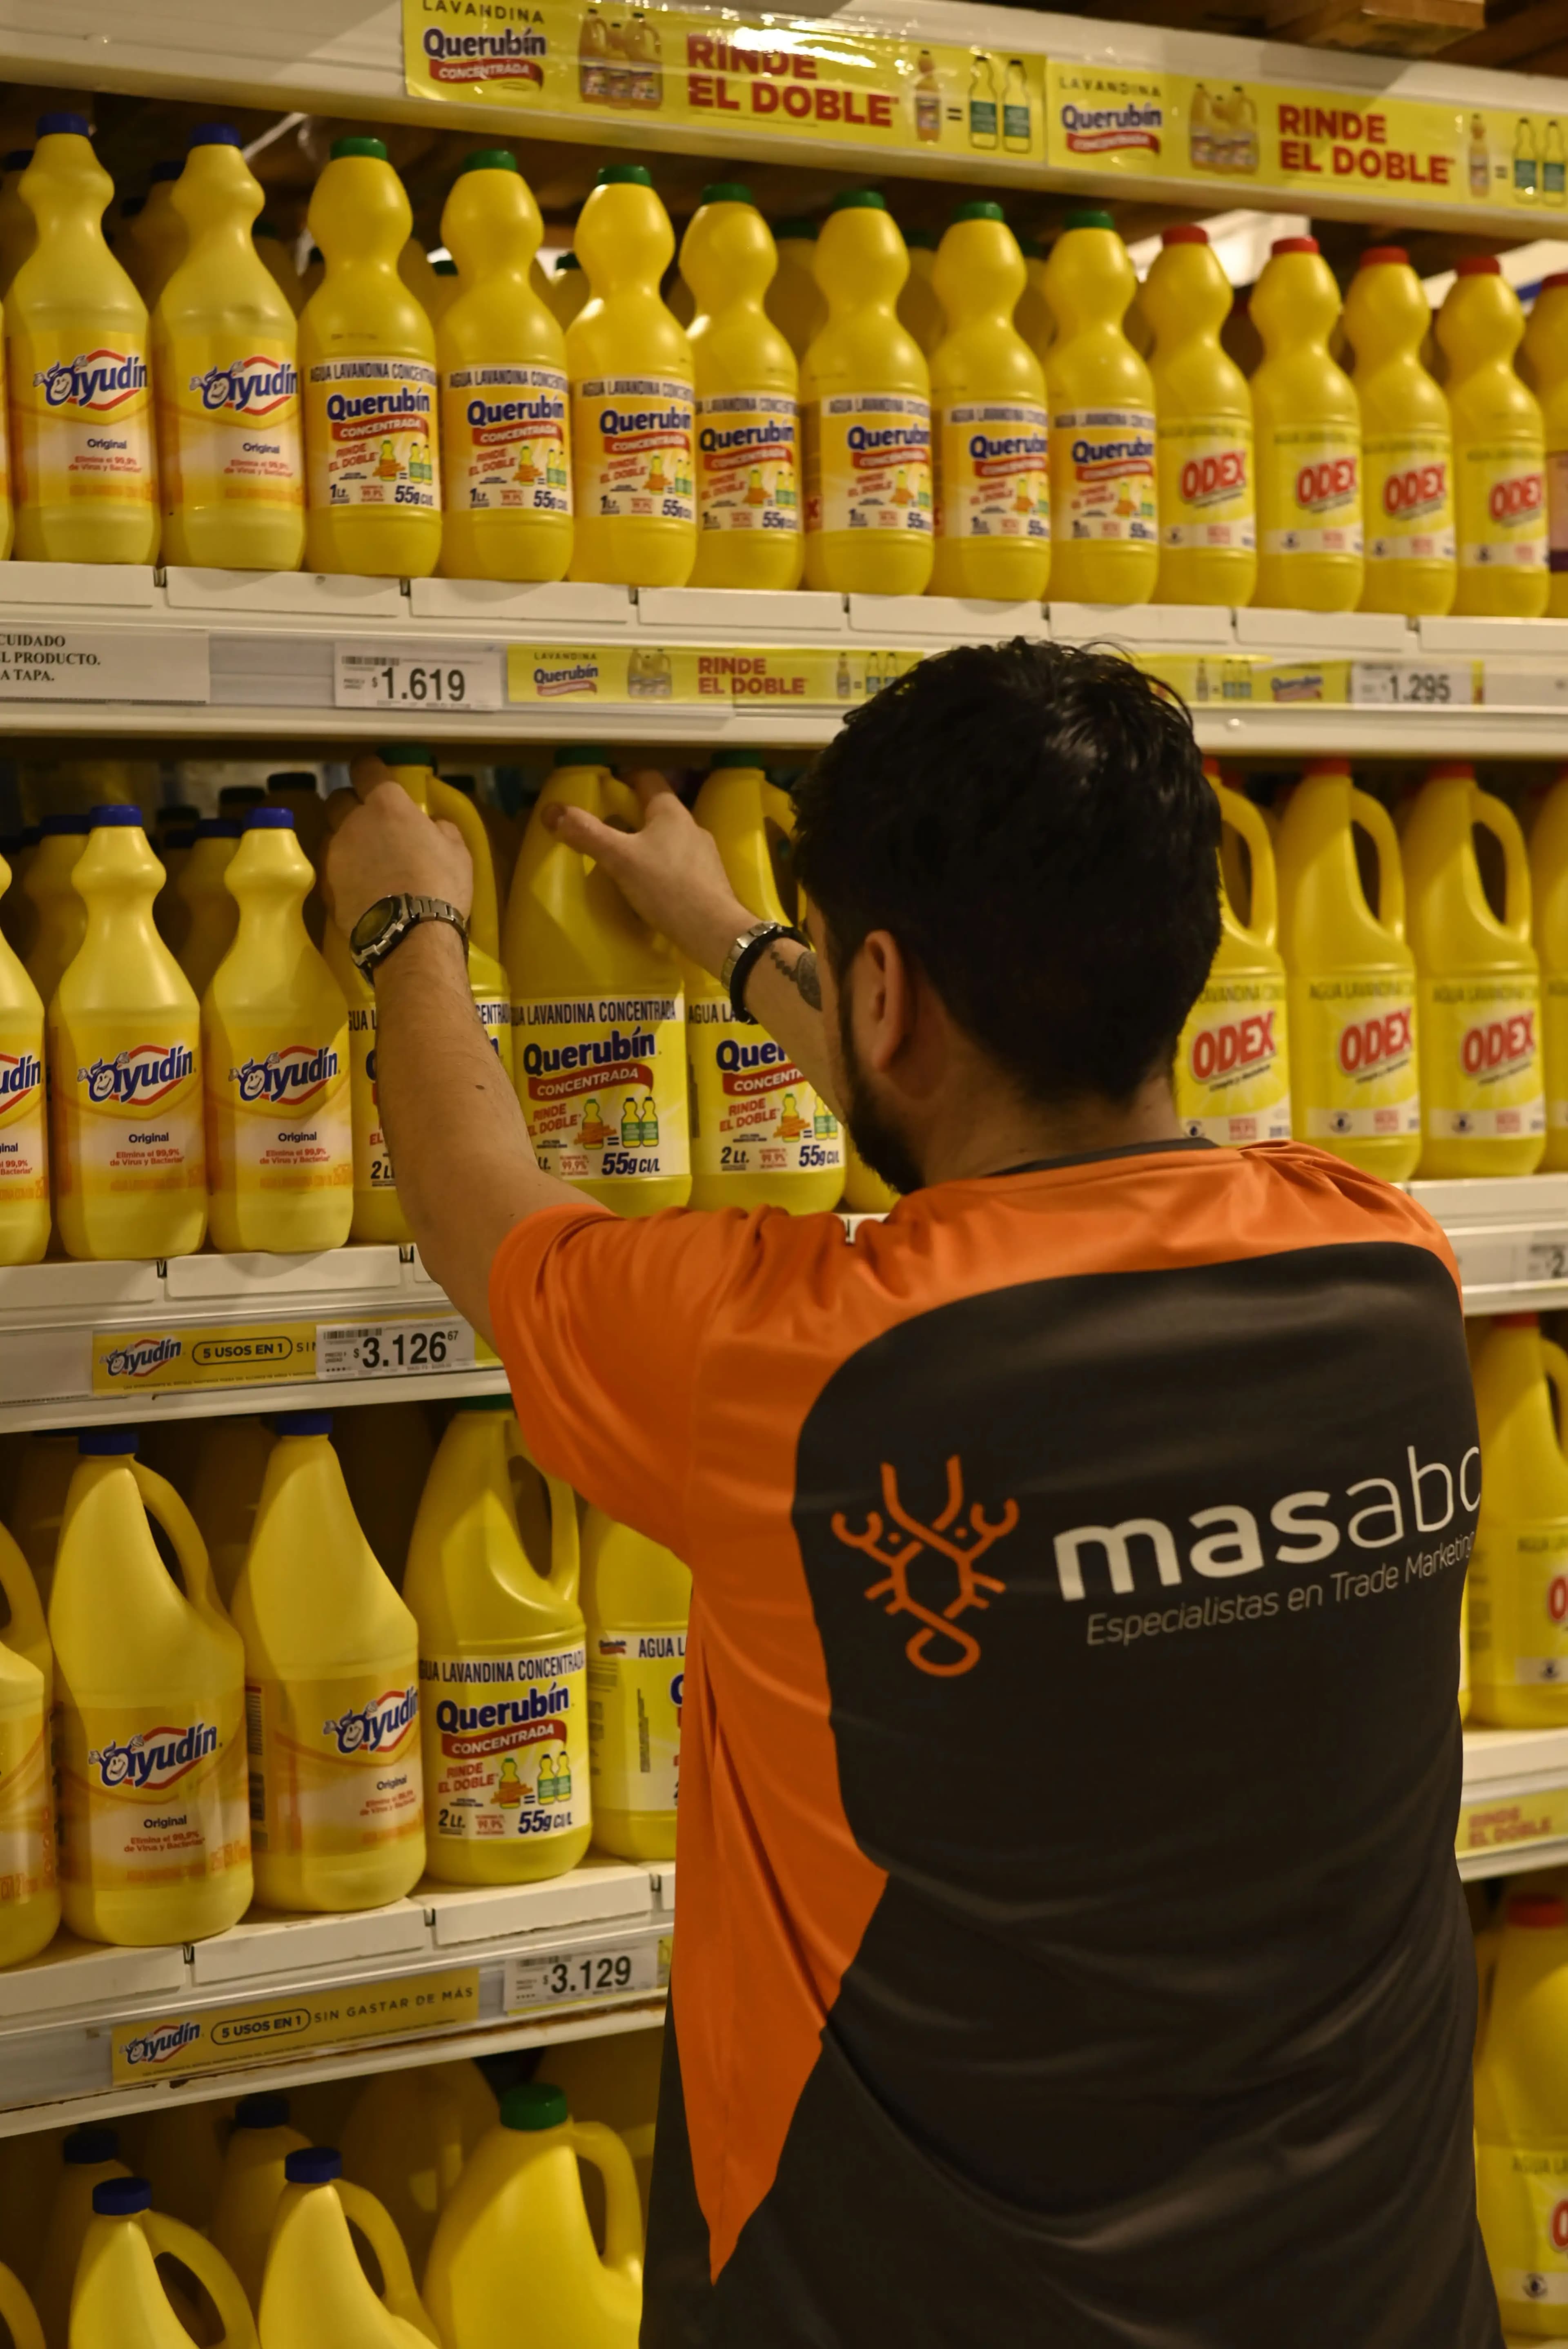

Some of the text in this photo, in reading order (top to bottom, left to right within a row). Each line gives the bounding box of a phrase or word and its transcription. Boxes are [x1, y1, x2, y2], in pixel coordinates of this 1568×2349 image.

[422, 0, 545, 24] LAVANDINA
[423, 28, 546, 58] Querubín
[688, 73, 740, 110] EL
[1278, 105, 1385, 144] RINDE
[1279, 141, 1322, 172] EL
[327, 388, 430, 421] Querubín
[468, 394, 564, 426] Querubín
[339, 418, 422, 438] CONCENTRADA
[849, 423, 930, 450] Querub
[87, 438, 127, 450] Original
[243, 442, 280, 454] Original
[0, 634, 65, 647] CUIDADO
[14, 652, 100, 666] PRODUCTO.
[698, 655, 767, 675] RINDE
[13, 669, 55, 682] TAPA.
[381, 666, 465, 702] 1.619
[534, 664, 598, 684] Querubín
[698, 677, 725, 695] EL
[1390, 673, 1452, 704] 1.295
[348, 1010, 368, 1031] GUA
[528, 999, 676, 1025] LAVANDINA CONCENTRADA
[688, 1003, 718, 1024] AGUA
[1193, 1010, 1275, 1080] ODEX
[1340, 1006, 1412, 1071] ODEX
[523, 1026, 655, 1076] Querubín
[716, 1040, 786, 1071] Quer
[537, 1068, 639, 1096] CONCENTRADA
[734, 1068, 803, 1092] CONCENT
[533, 1103, 566, 1121] RINDE
[728, 1098, 765, 1116] RINDE
[278, 1132, 317, 1143] Original
[719, 1120, 733, 1132] EL
[129, 1132, 169, 1144] Original
[370, 1132, 383, 1146] EL
[602, 1152, 637, 1175] 55g
[721, 1146, 731, 1164] 2
[799, 1145, 825, 1167] 55g
[370, 1161, 381, 1179] 2
[203, 1348, 211, 1358] 5
[215, 1345, 252, 1358] USOS
[255, 1344, 274, 1355] EN
[278, 1344, 283, 1353] 1
[353, 1348, 360, 1359] $
[362, 1331, 446, 1368] 3.126
[448, 1331, 459, 1341] 67
[1086, 1531, 1475, 1646] Especialistas en Trade Marketin
[639, 1638, 675, 1658] AGUA
[419, 1663, 439, 1681] GUA
[442, 1659, 514, 1683] LAVANDINA
[437, 1682, 569, 1733] Querubín
[451, 1723, 555, 1755] CONCENTRADA
[447, 1763, 483, 1778] RINDE
[438, 1782, 450, 1793] EL
[144, 1815, 187, 1829] Original
[438, 1809, 449, 1826] 2
[518, 1810, 552, 1834] 55g
[551, 1955, 631, 1993] 3.129
[223, 1987, 473, 2038] 5 USOS EN 1 SIN GASTAR DE MÁS
